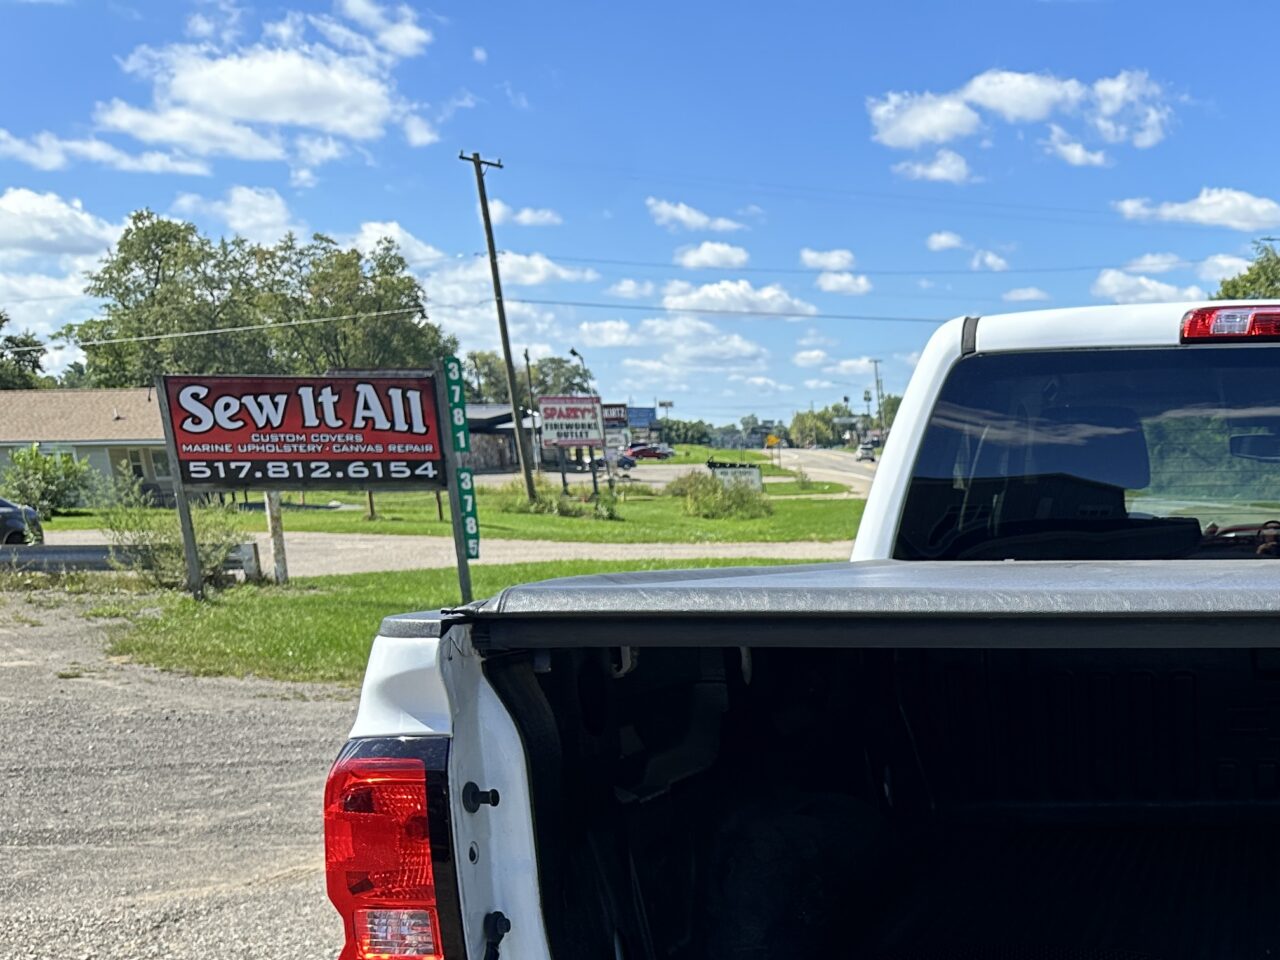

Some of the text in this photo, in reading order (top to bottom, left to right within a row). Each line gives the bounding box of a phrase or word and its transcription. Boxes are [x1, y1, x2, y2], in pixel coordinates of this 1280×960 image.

[178, 383, 430, 435] Sew It All
[447, 361, 467, 450] 3781
[544, 422, 600, 431] FIREWORKS
[250, 433, 364, 443] CUSTOM COVERS
[556, 431, 590, 439] OUTLET
[182, 443, 434, 453] MARINE UPHOLSTERY CANVAS REPAIR
[188, 460, 438, 478] 517.812.6154
[460, 471, 479, 557] 3785
